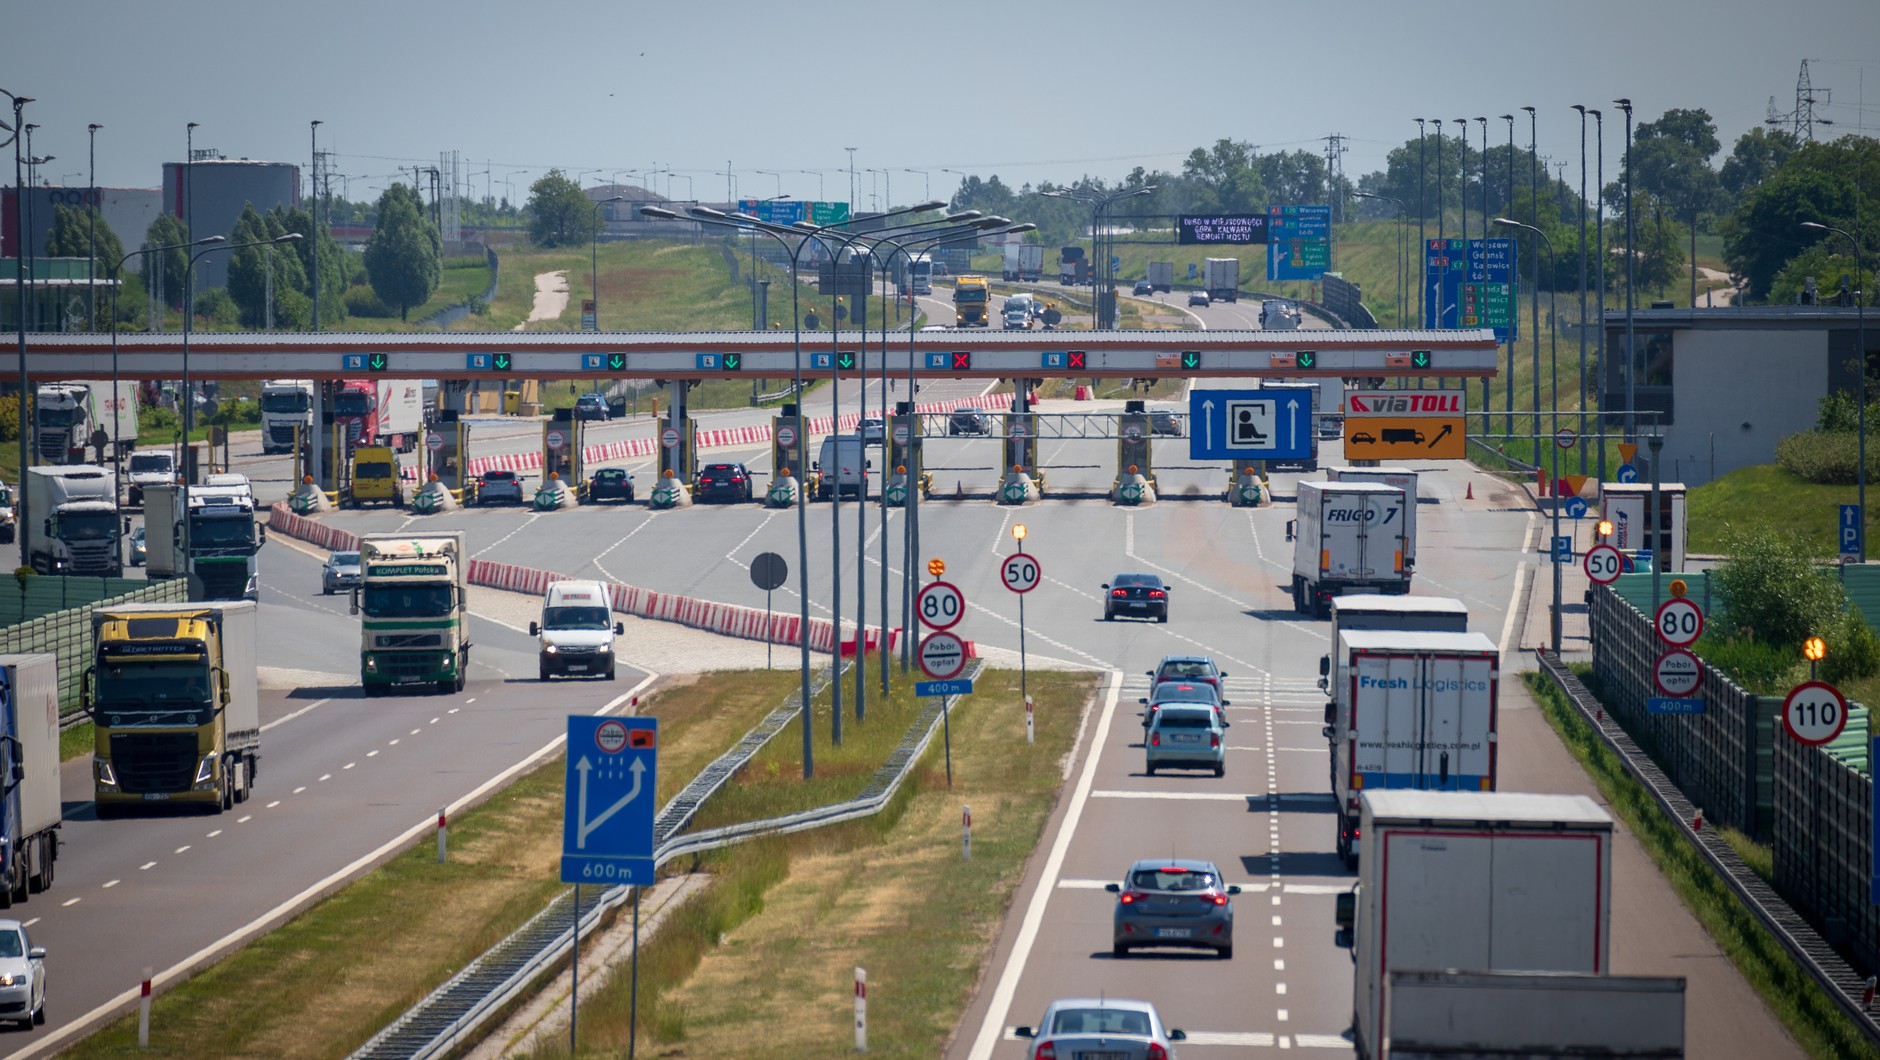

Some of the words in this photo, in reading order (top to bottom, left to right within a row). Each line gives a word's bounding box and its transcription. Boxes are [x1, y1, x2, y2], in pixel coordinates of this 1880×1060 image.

[1472, 272, 1492, 280] Łóź
[1373, 395, 1460, 413] viaTOLL
[1327, 509, 1375, 522] FRIGO
[1382, 507, 1398, 524] 7
[1843, 528, 1857, 545] P
[376, 567, 412, 575] KOMPLET
[414, 566, 440, 574] Polska
[1590, 555, 1618, 574] 50
[1007, 564, 1036, 583] 50
[923, 594, 958, 618] 80
[1662, 611, 1697, 635] 80
[929, 643, 955, 651] Pobór
[1665, 659, 1692, 669] Pobór
[928, 684, 948, 693] 400
[1360, 676, 1407, 689] Fresh
[1412, 677, 1487, 693] Logistics
[1659, 702, 1681, 711] 400
[1795, 702, 1837, 727] 110
[582, 863, 615, 878] 600
[619, 868, 632, 879] m
